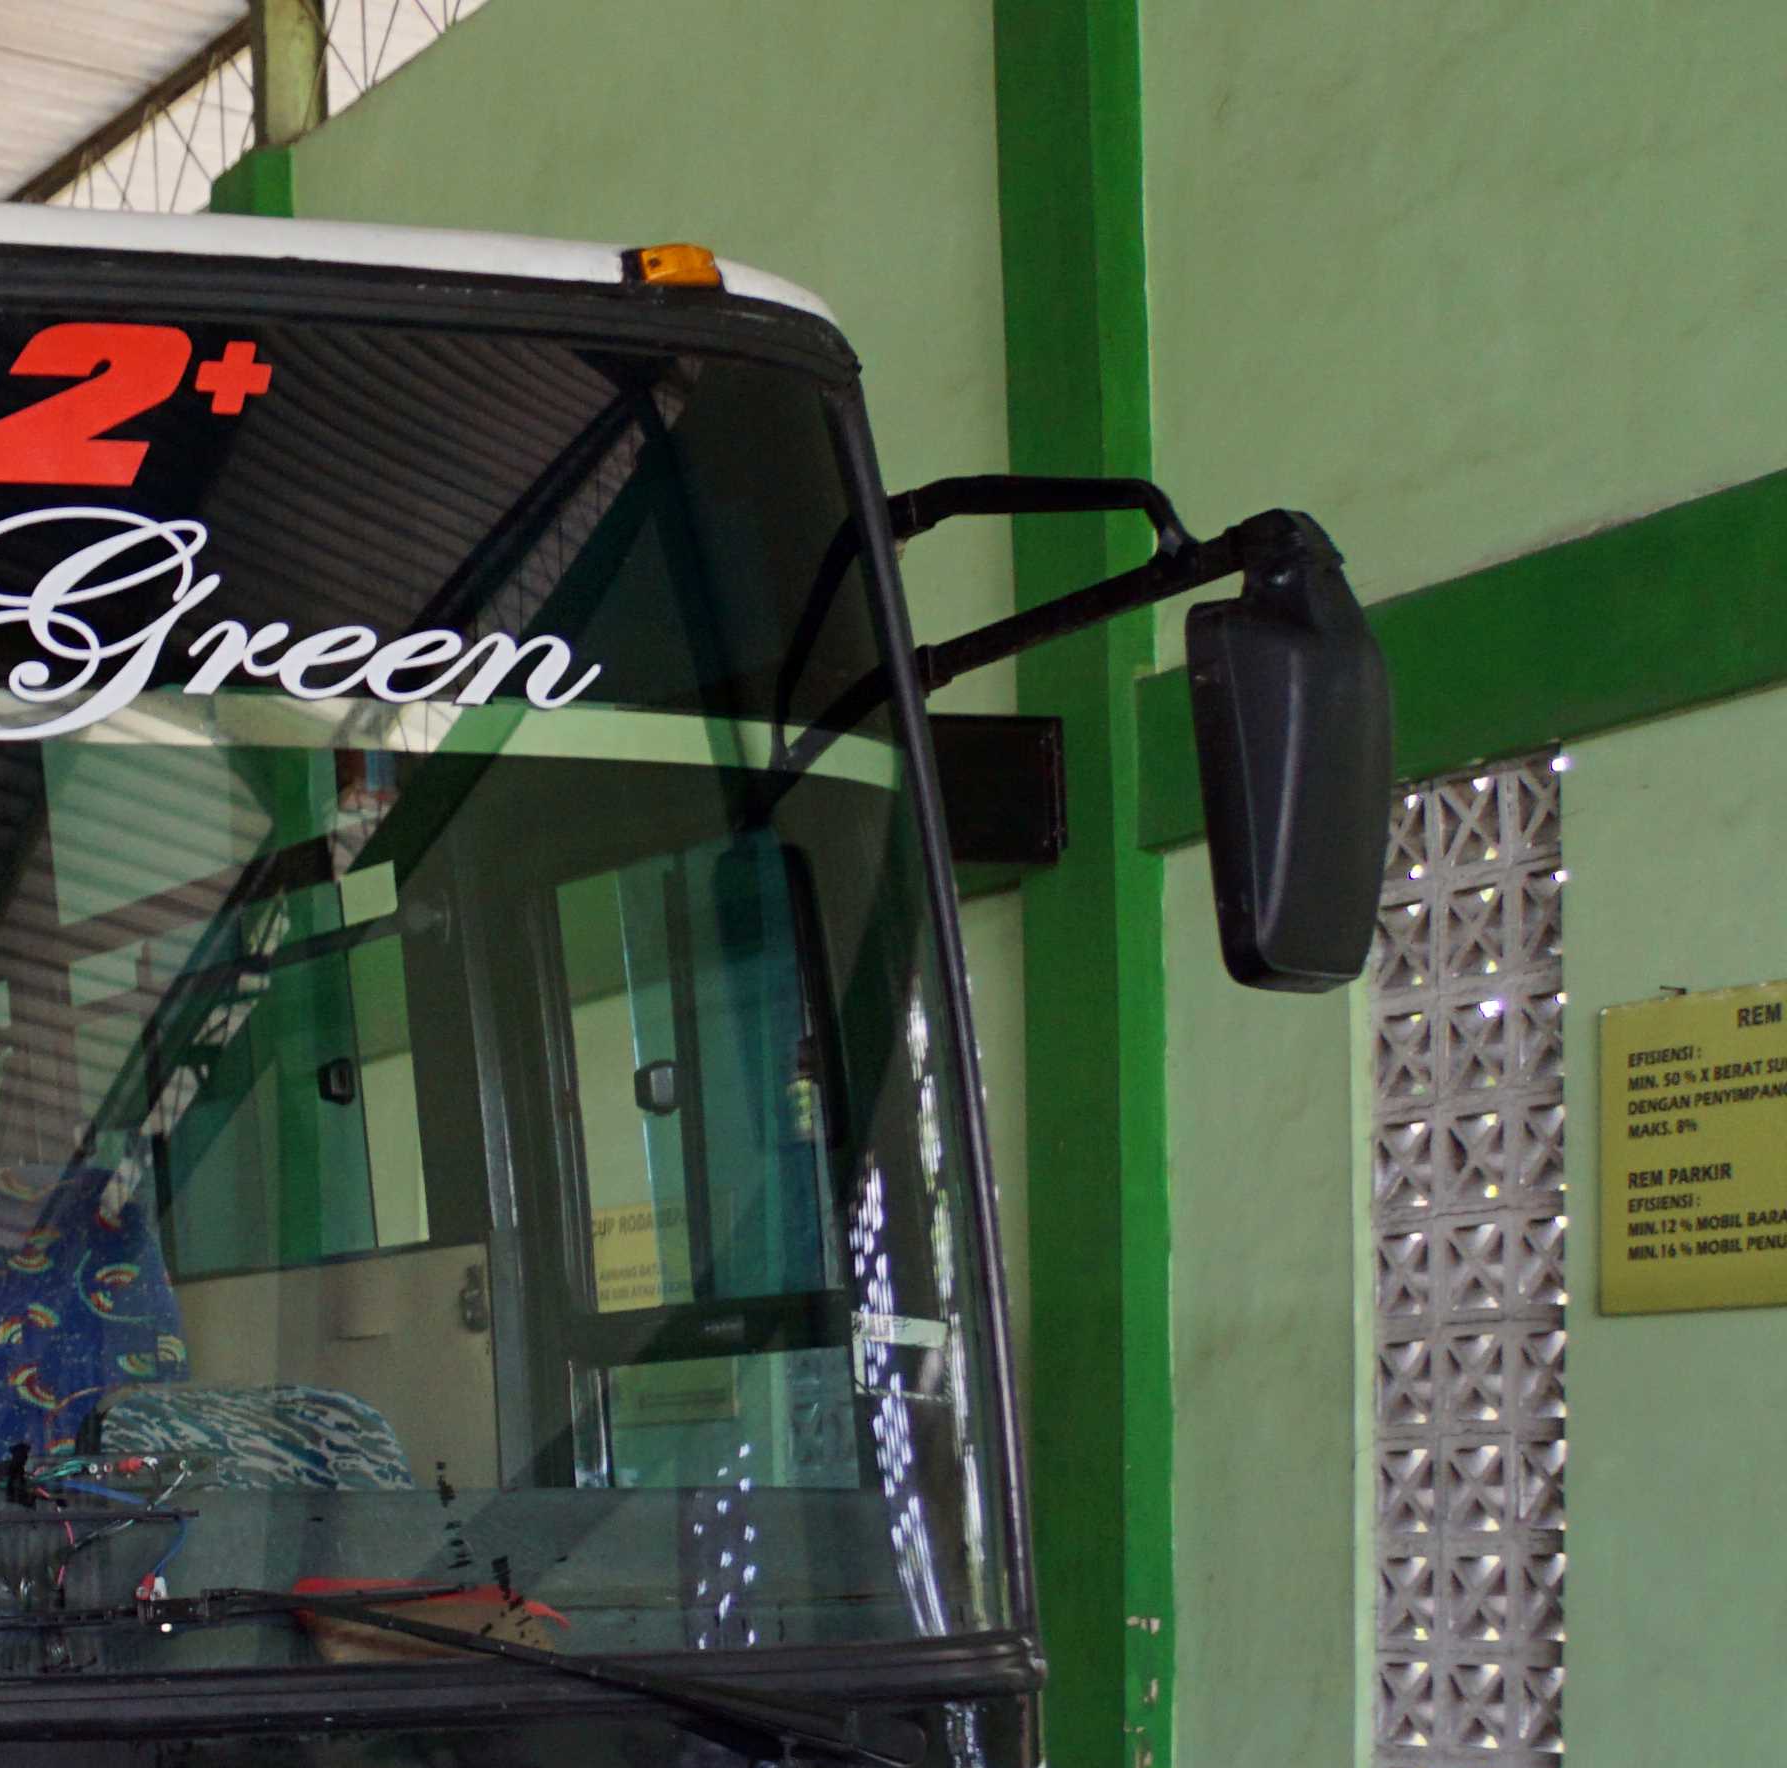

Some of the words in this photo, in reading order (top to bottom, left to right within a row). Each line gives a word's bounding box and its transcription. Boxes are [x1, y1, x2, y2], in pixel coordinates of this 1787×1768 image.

[1737, 1002, 1782, 1028] REM
[1628, 1046, 1694, 1068] EFISIENSI
[1713, 1060, 1763, 1081] BERAT
[1628, 1095, 1691, 1115] DENGAN
[1628, 1170, 1663, 1189] REM
[1668, 1162, 1732, 1184] PARKIR
[1628, 1194, 1694, 1213] EFISIENSI
[1695, 1213, 1742, 1231] MOBIL
[1695, 1238, 1743, 1256] MOBIL
